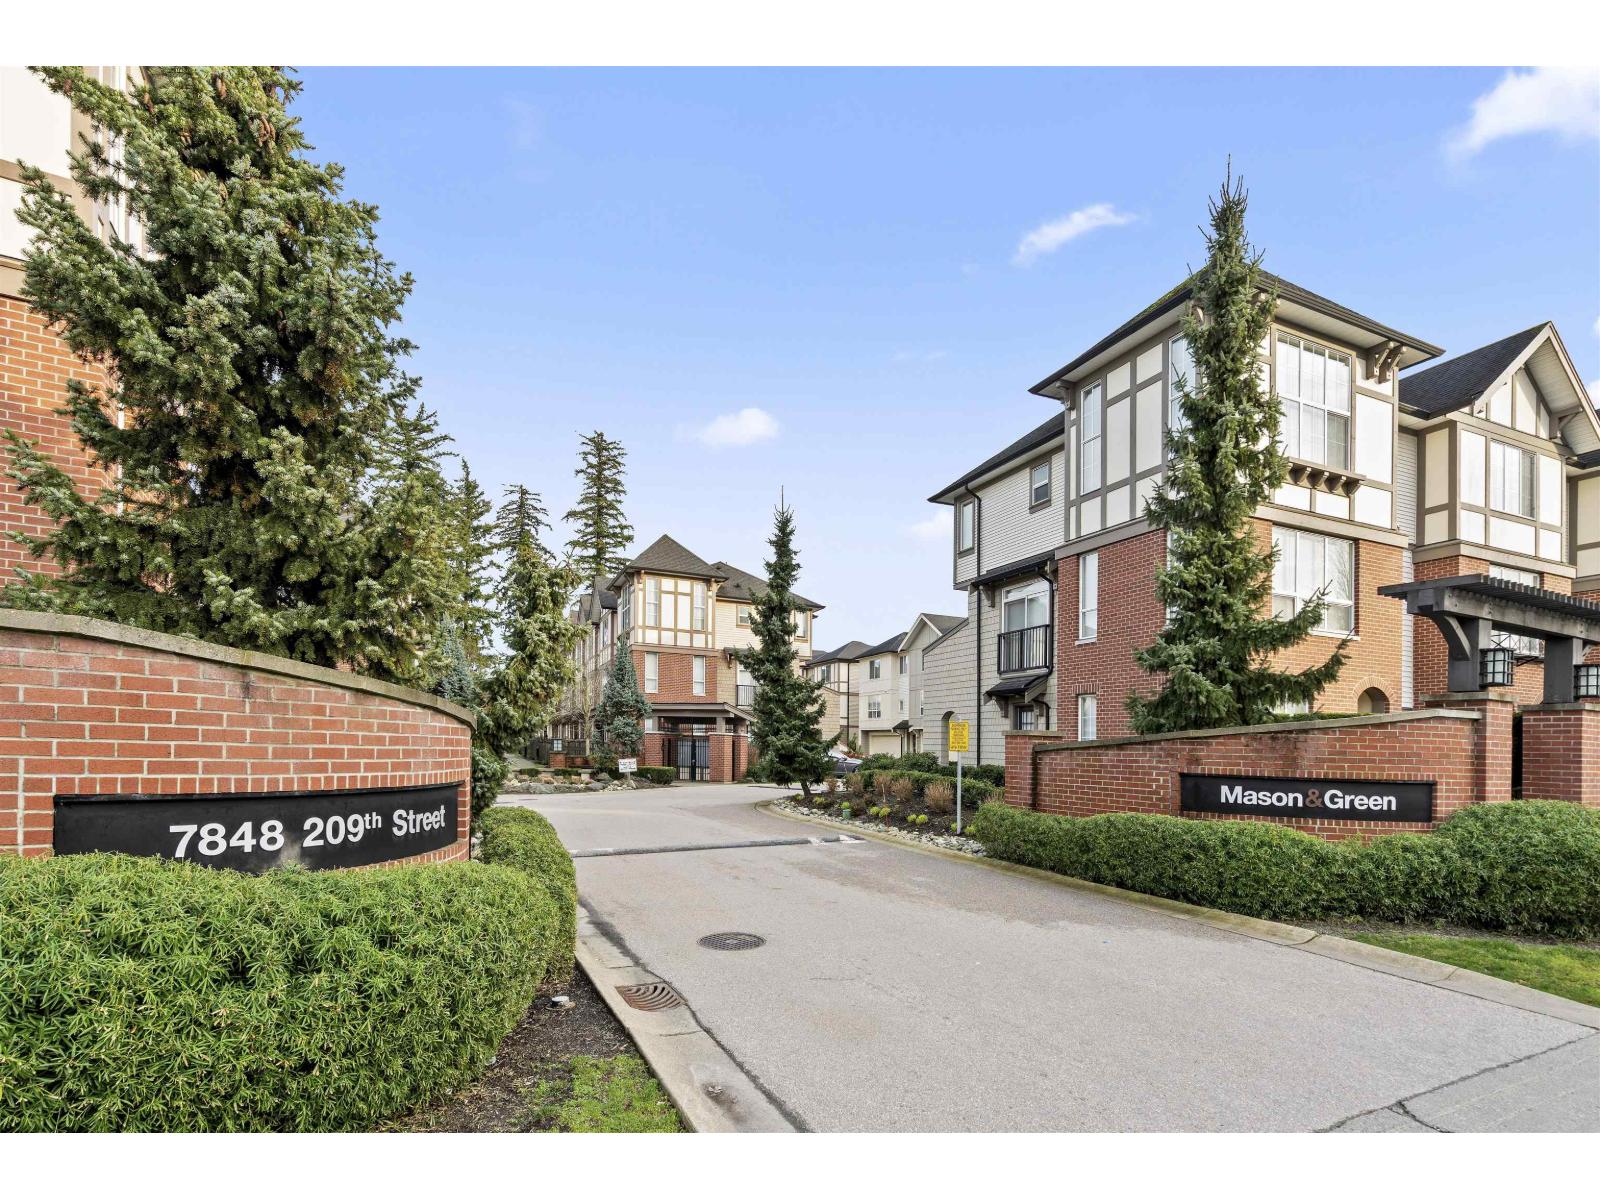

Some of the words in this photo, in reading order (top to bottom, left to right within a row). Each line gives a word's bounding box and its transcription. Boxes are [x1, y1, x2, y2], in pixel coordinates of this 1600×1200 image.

[1220, 785, 1397, 811] Mason&Green
[169, 819, 285, 858] 7848
[302, 812, 382, 848] 209th
[392, 804, 446, 837] Street
